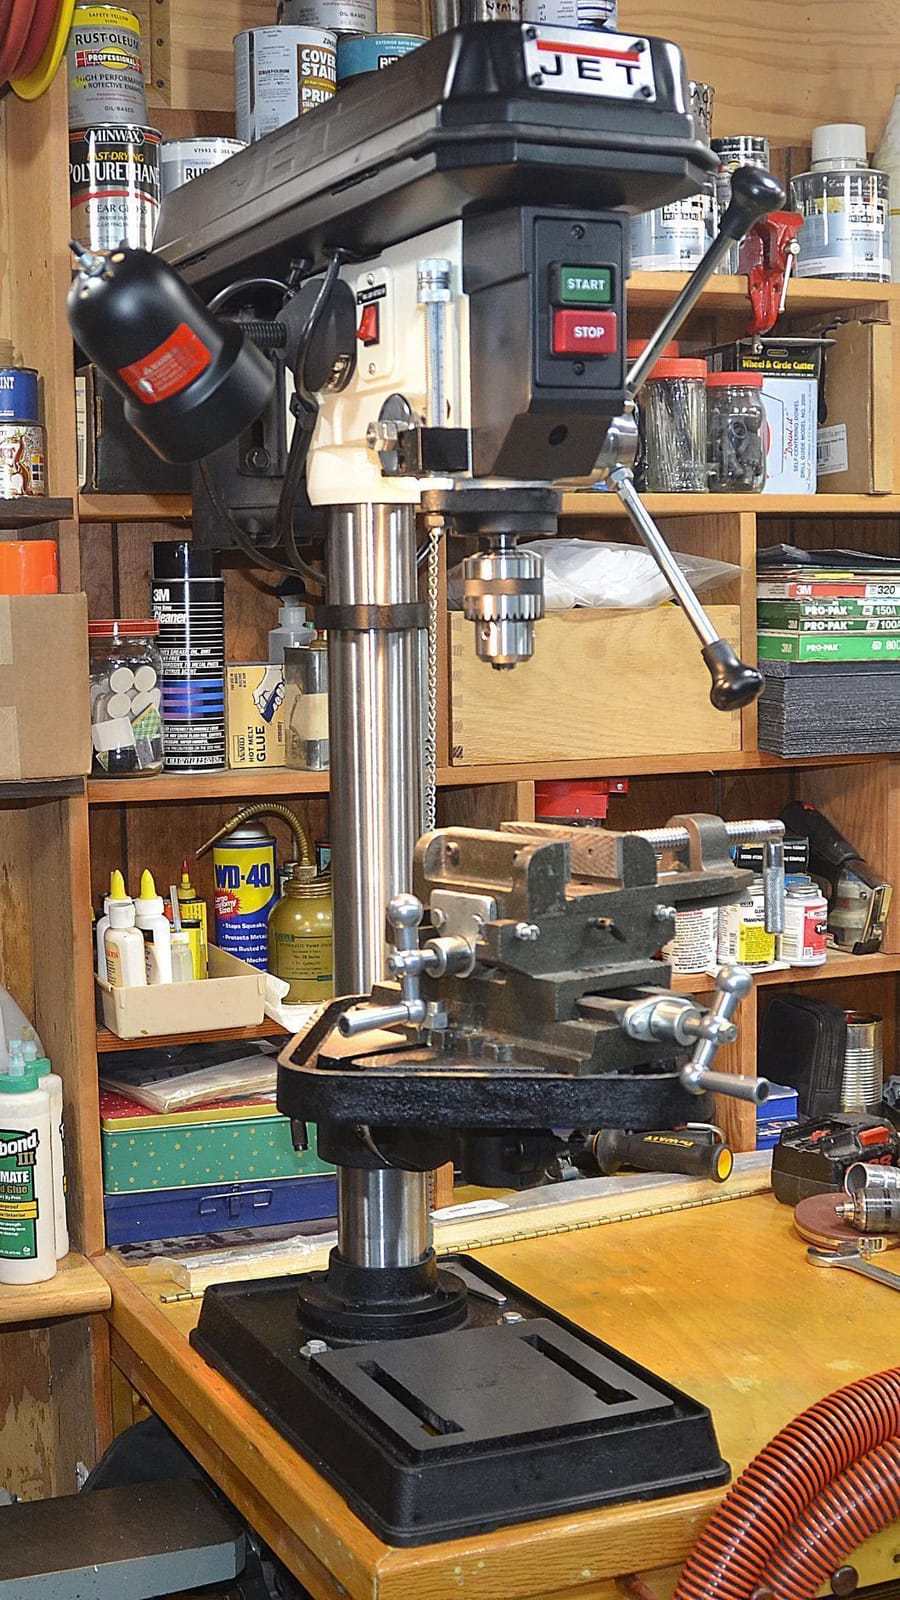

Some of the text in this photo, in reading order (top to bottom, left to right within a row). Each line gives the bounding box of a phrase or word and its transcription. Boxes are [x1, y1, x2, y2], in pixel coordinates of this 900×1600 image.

[88, 54, 137, 66] PROFESSIONAL
[540, 54, 641, 85] JET
[90, 129, 141, 143] MINWAX
[567, 279, 606, 291] START
[574, 326, 605, 338] STOP
[742, 360, 765, 369] Wheel
[773, 361, 792, 369] Circle
[793, 362, 815, 370] Cutter
[153, 588, 170, 602] 3M
[796, 585, 896, 595] 3M 320
[876, 606, 897, 615] 150A
[154, 611, 187, 624] Cleaner
[788, 620, 798, 629] 3M
[781, 643, 793, 653] 3M
[255, 725, 266, 762] GLUE
[215, 863, 272, 889] WD-40
[17, 1151, 35, 1165] III
[7, 1186, 28, 1194] Glue
